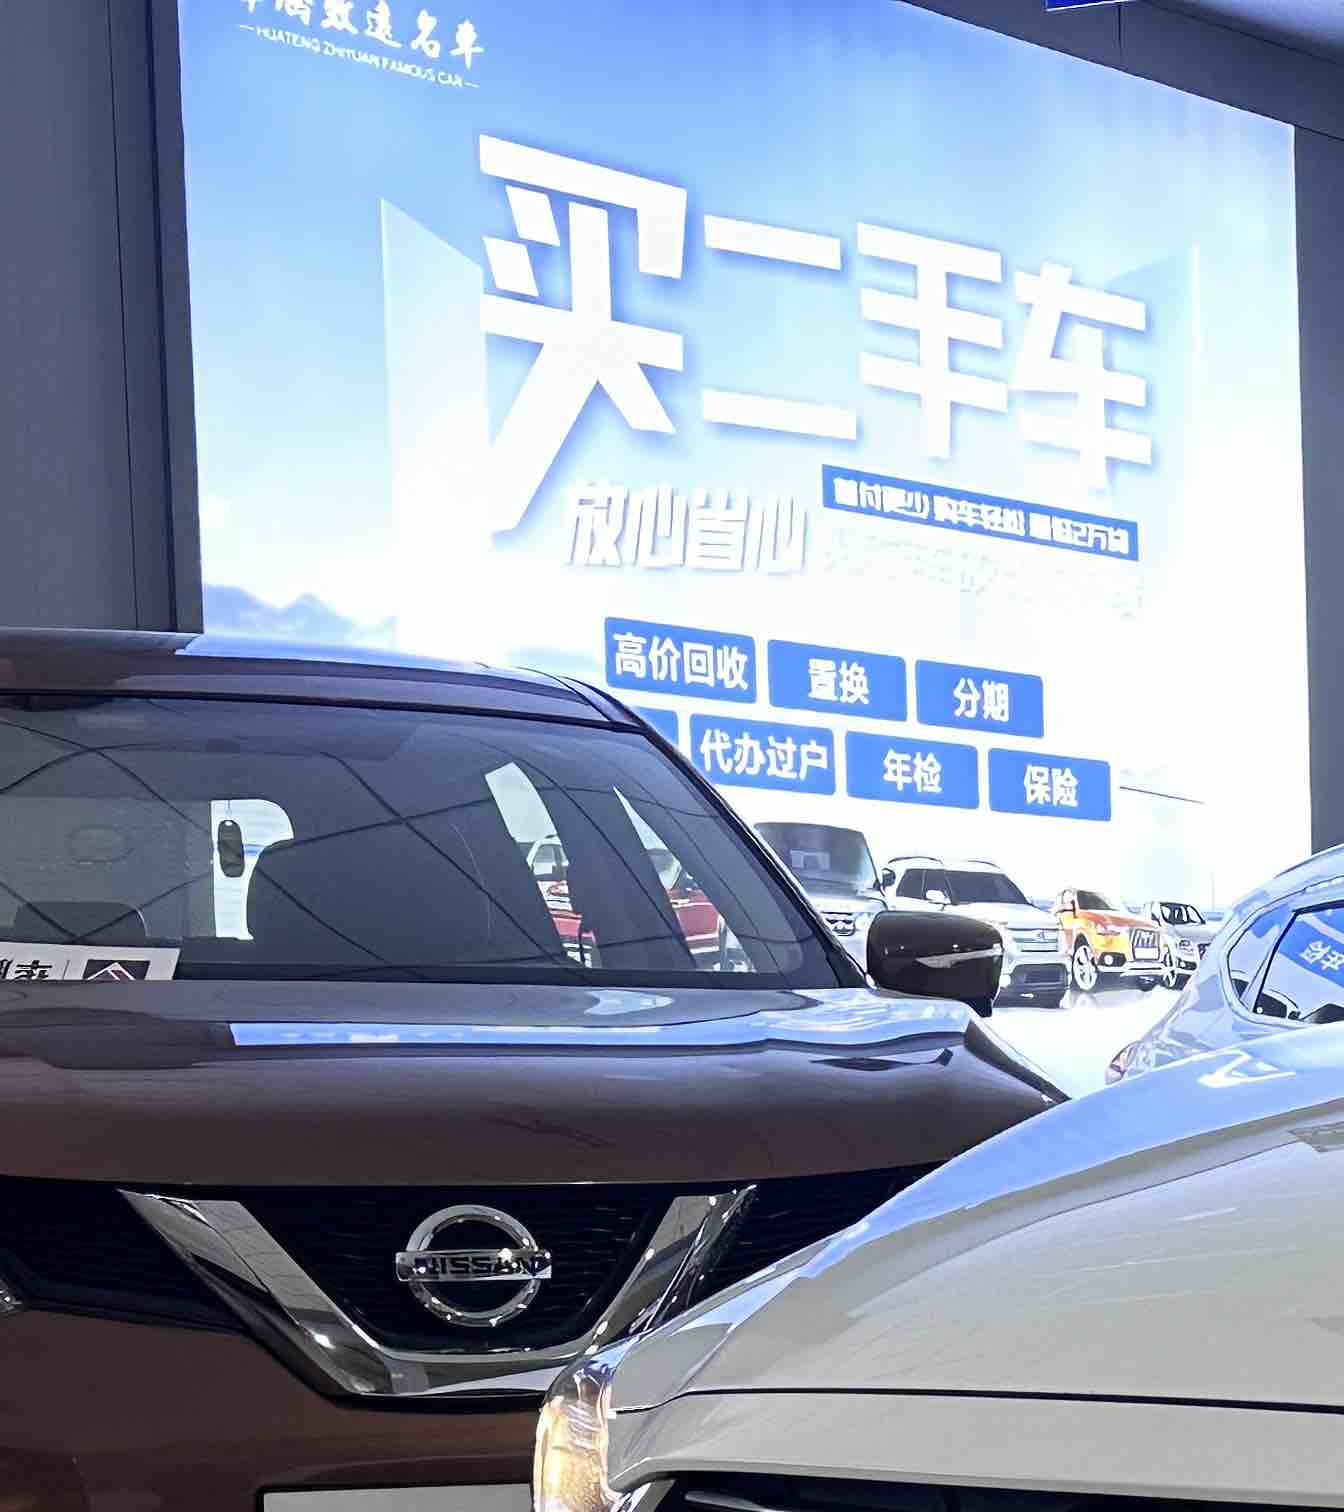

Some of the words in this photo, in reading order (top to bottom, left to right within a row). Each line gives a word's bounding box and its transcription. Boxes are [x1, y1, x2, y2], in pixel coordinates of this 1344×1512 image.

[476, 133, 1154, 543] 买二手车
[563, 479, 808, 575] 放心省心
[612, 631, 750, 691] 高价回收
[807, 658, 871, 705] 置换
[953, 677, 1010, 723] 分期
[699, 728, 829, 780] 代办过户
[882, 749, 943, 795] 年检
[1023, 764, 1080, 808] 保险
